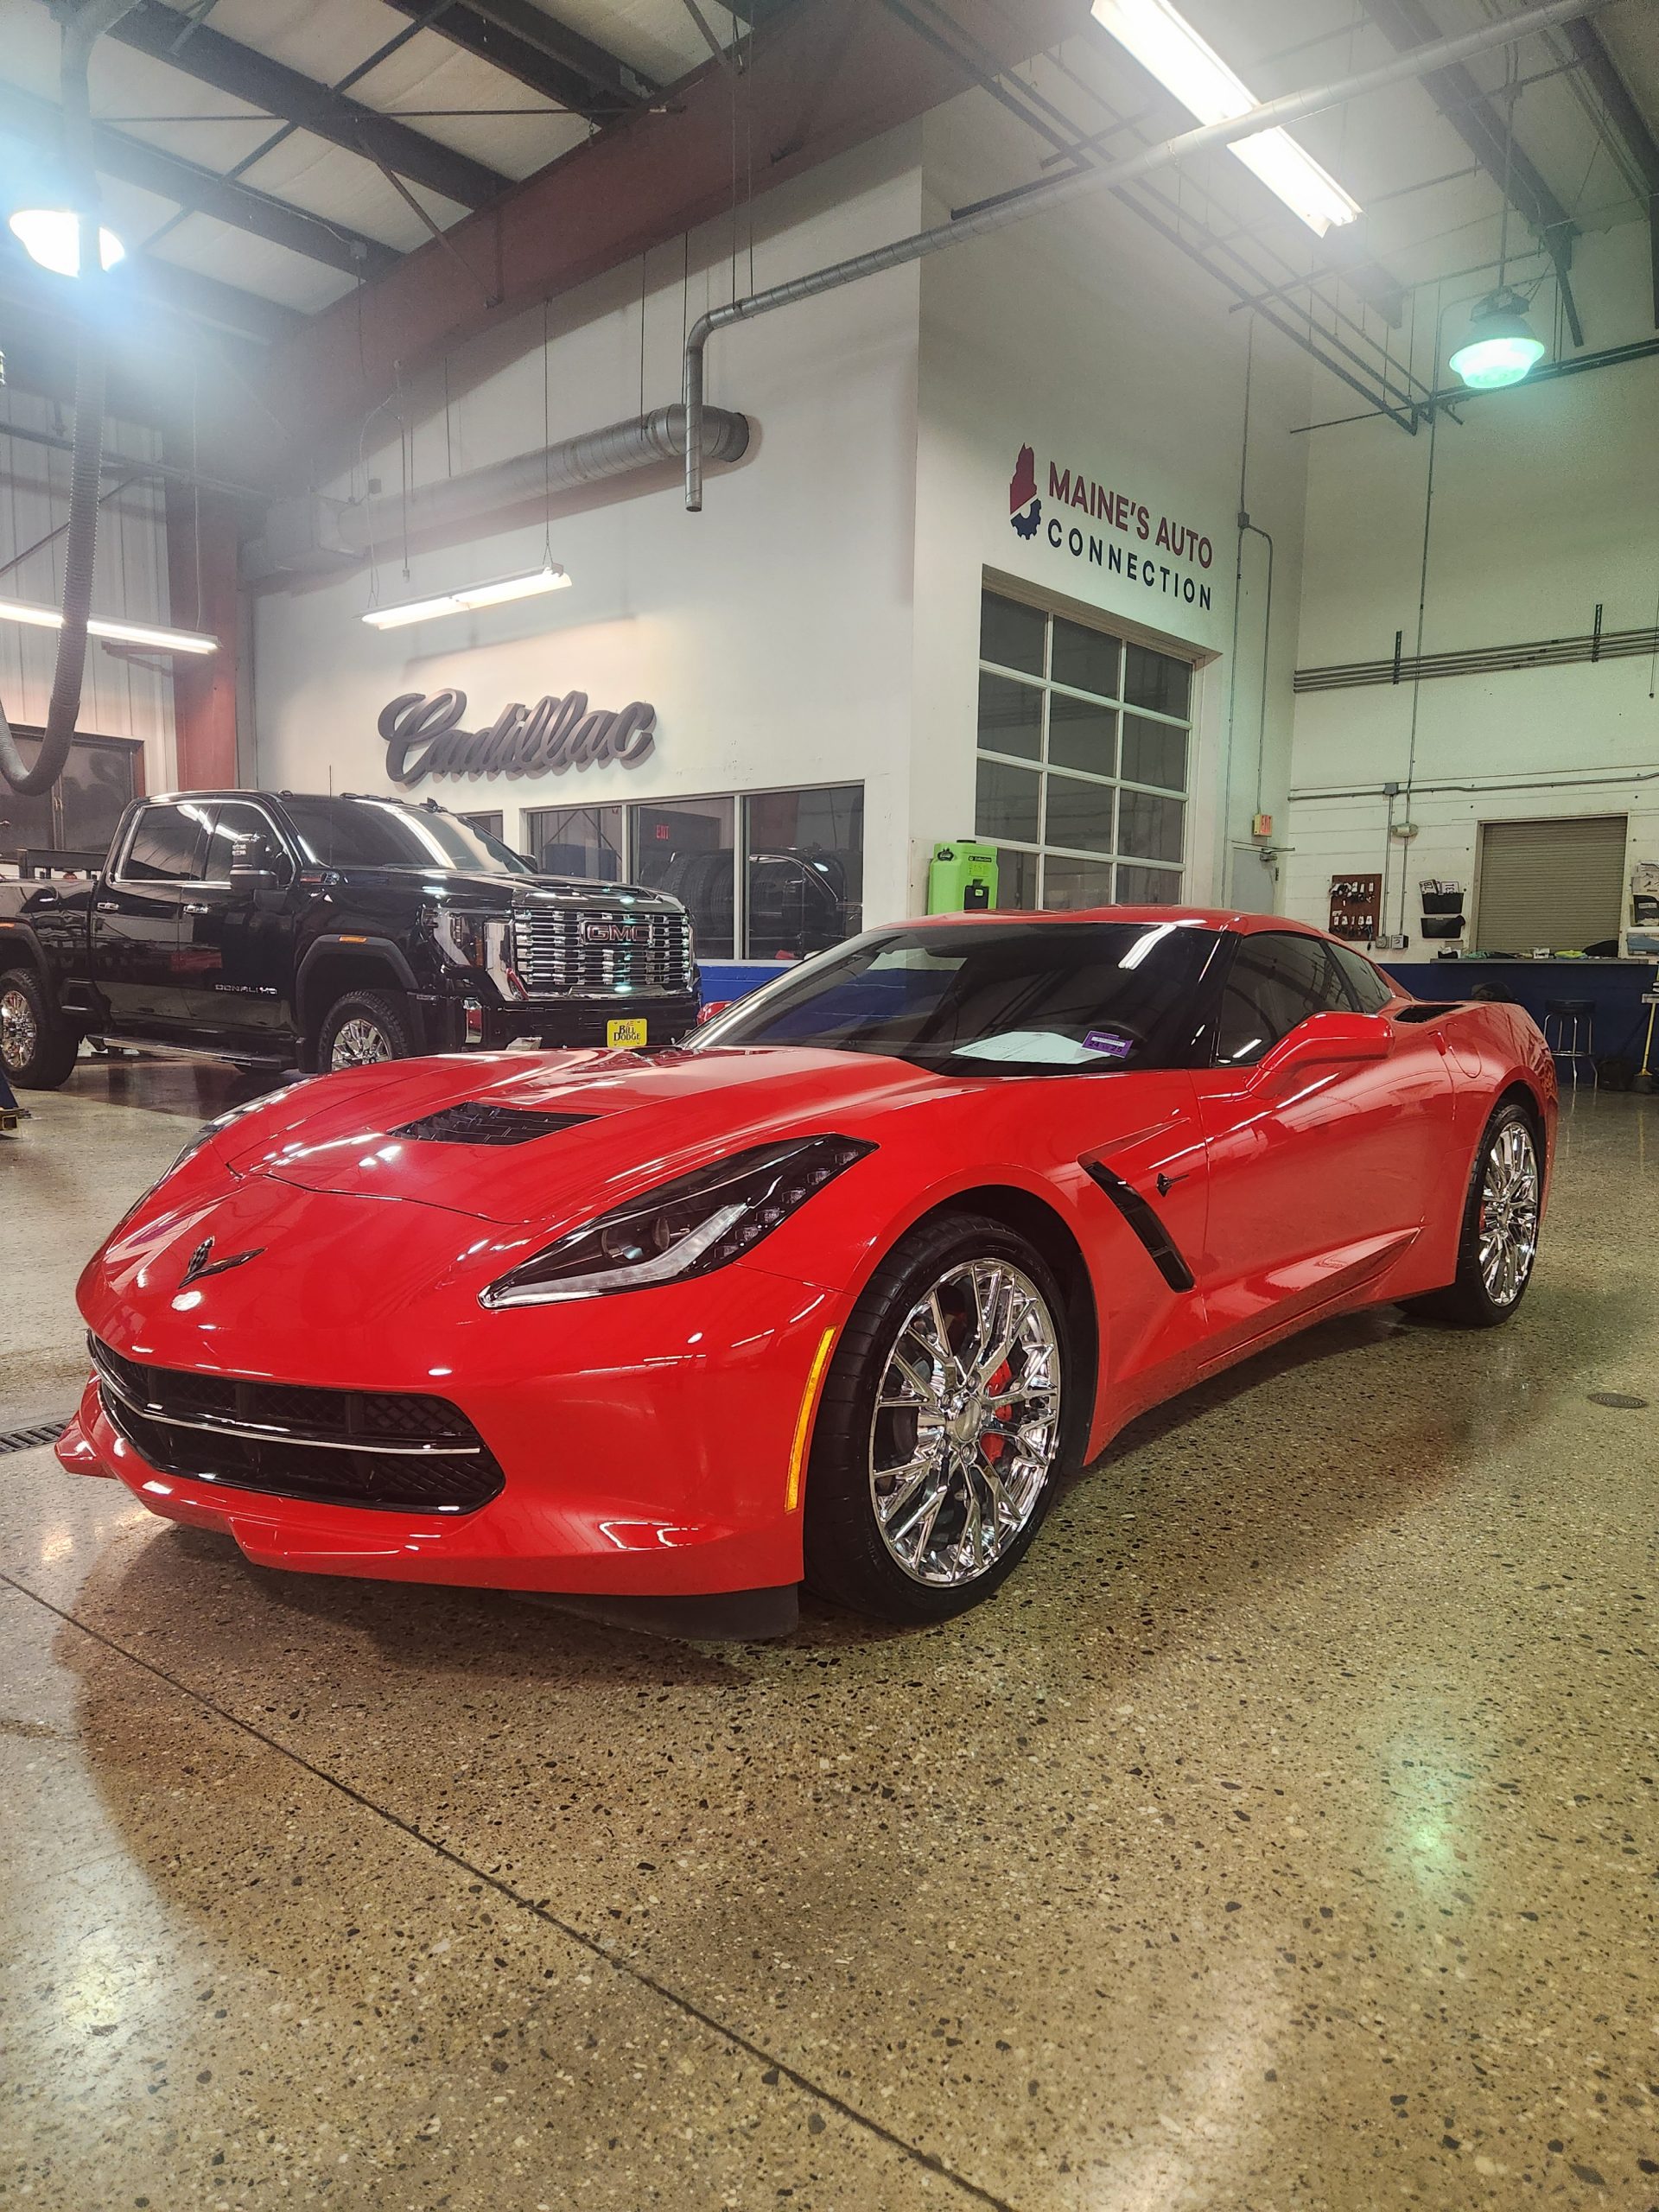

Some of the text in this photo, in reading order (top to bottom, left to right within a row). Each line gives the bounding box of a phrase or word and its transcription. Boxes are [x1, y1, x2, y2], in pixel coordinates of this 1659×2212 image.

[1049, 461, 1212, 569] MAINE'S AUTO
[1047, 518, 1211, 610] CONNECTION
[378, 688, 656, 785] Cadillac
[588, 925, 651, 942] GMC
[613, 1032, 641, 1041] DODGE
[619, 1025, 637, 1035] BILL
